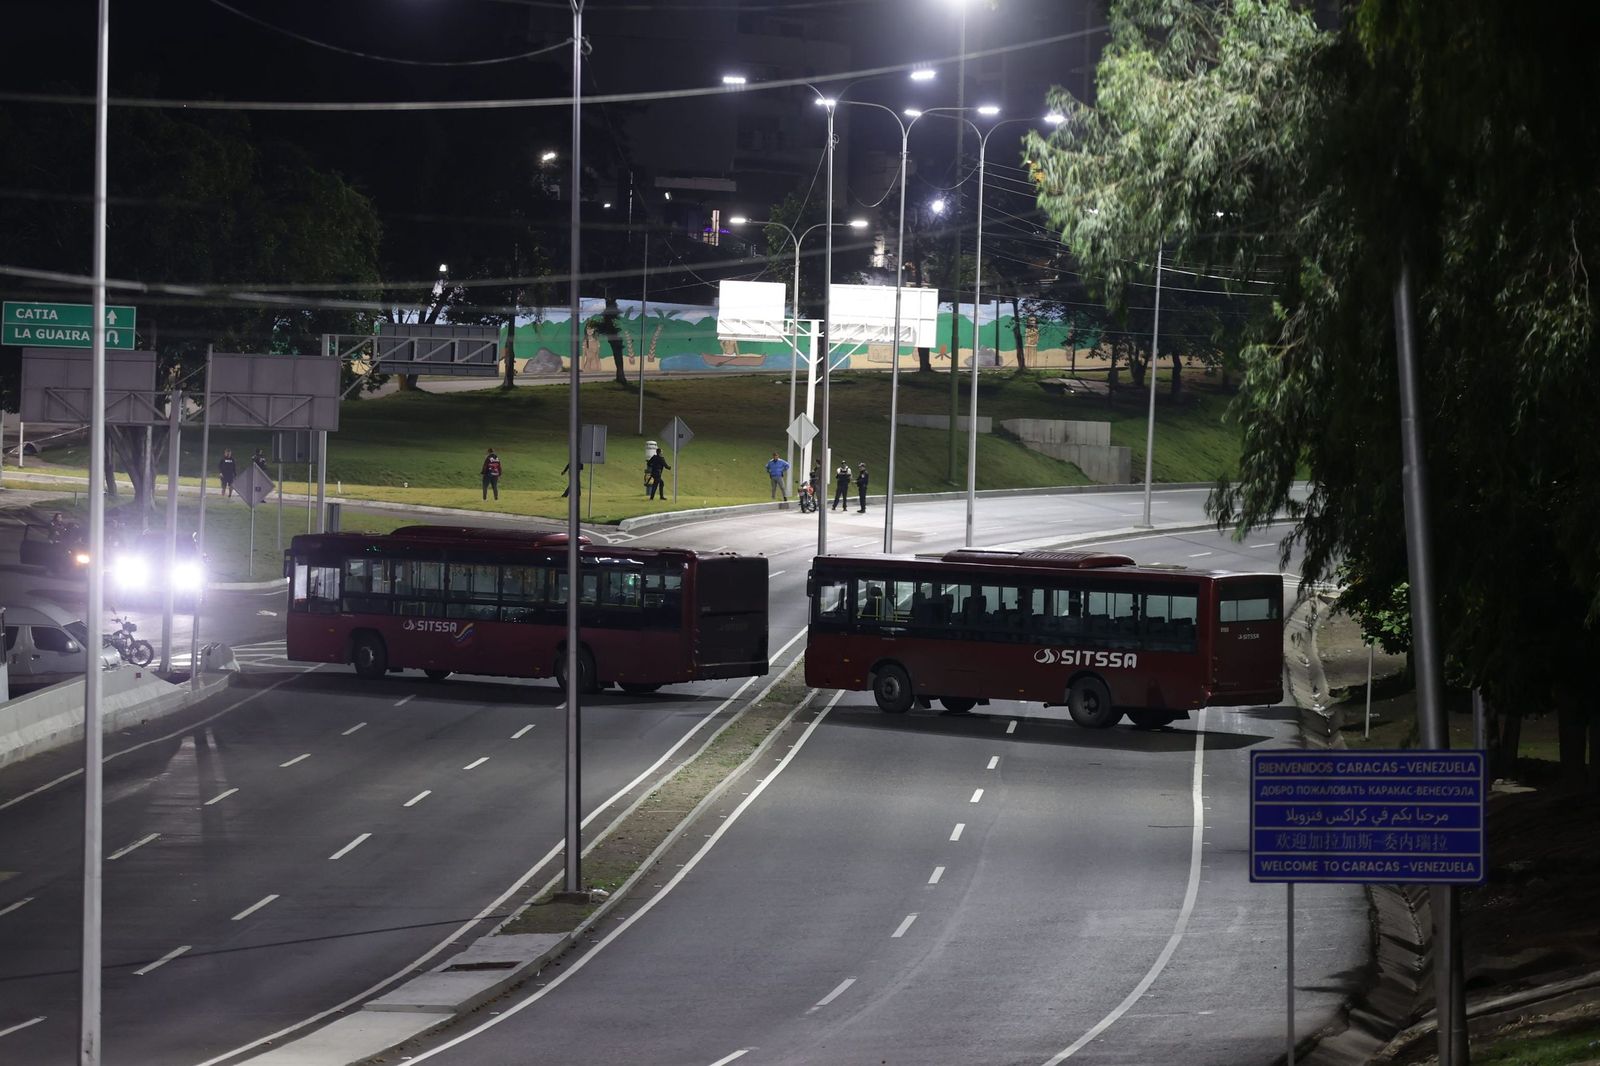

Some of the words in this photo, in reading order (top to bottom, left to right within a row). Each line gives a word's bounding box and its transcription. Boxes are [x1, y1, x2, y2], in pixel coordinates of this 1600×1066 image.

[15, 308, 59, 320] CATIA
[14, 328, 32, 339] LA
[35, 329, 91, 341] GUAIRA
[416, 620, 458, 633] SITSSA
[1060, 649, 1138, 669] SITSSA
[1258, 762, 1334, 774] BIENVENIDOS
[1260, 785, 1294, 797] ДОБРО
[1296, 785, 1366, 796] ПОЖАЛОВАТЬ
[1325, 807, 1368, 826] كراكس
[1371, 807, 1389, 826] في
[1391, 807, 1412, 825] بكم
[1416, 807, 1450, 825] مرحبا
[1260, 860, 1319, 872] WELCOME
[1323, 860, 1340, 872] TO
